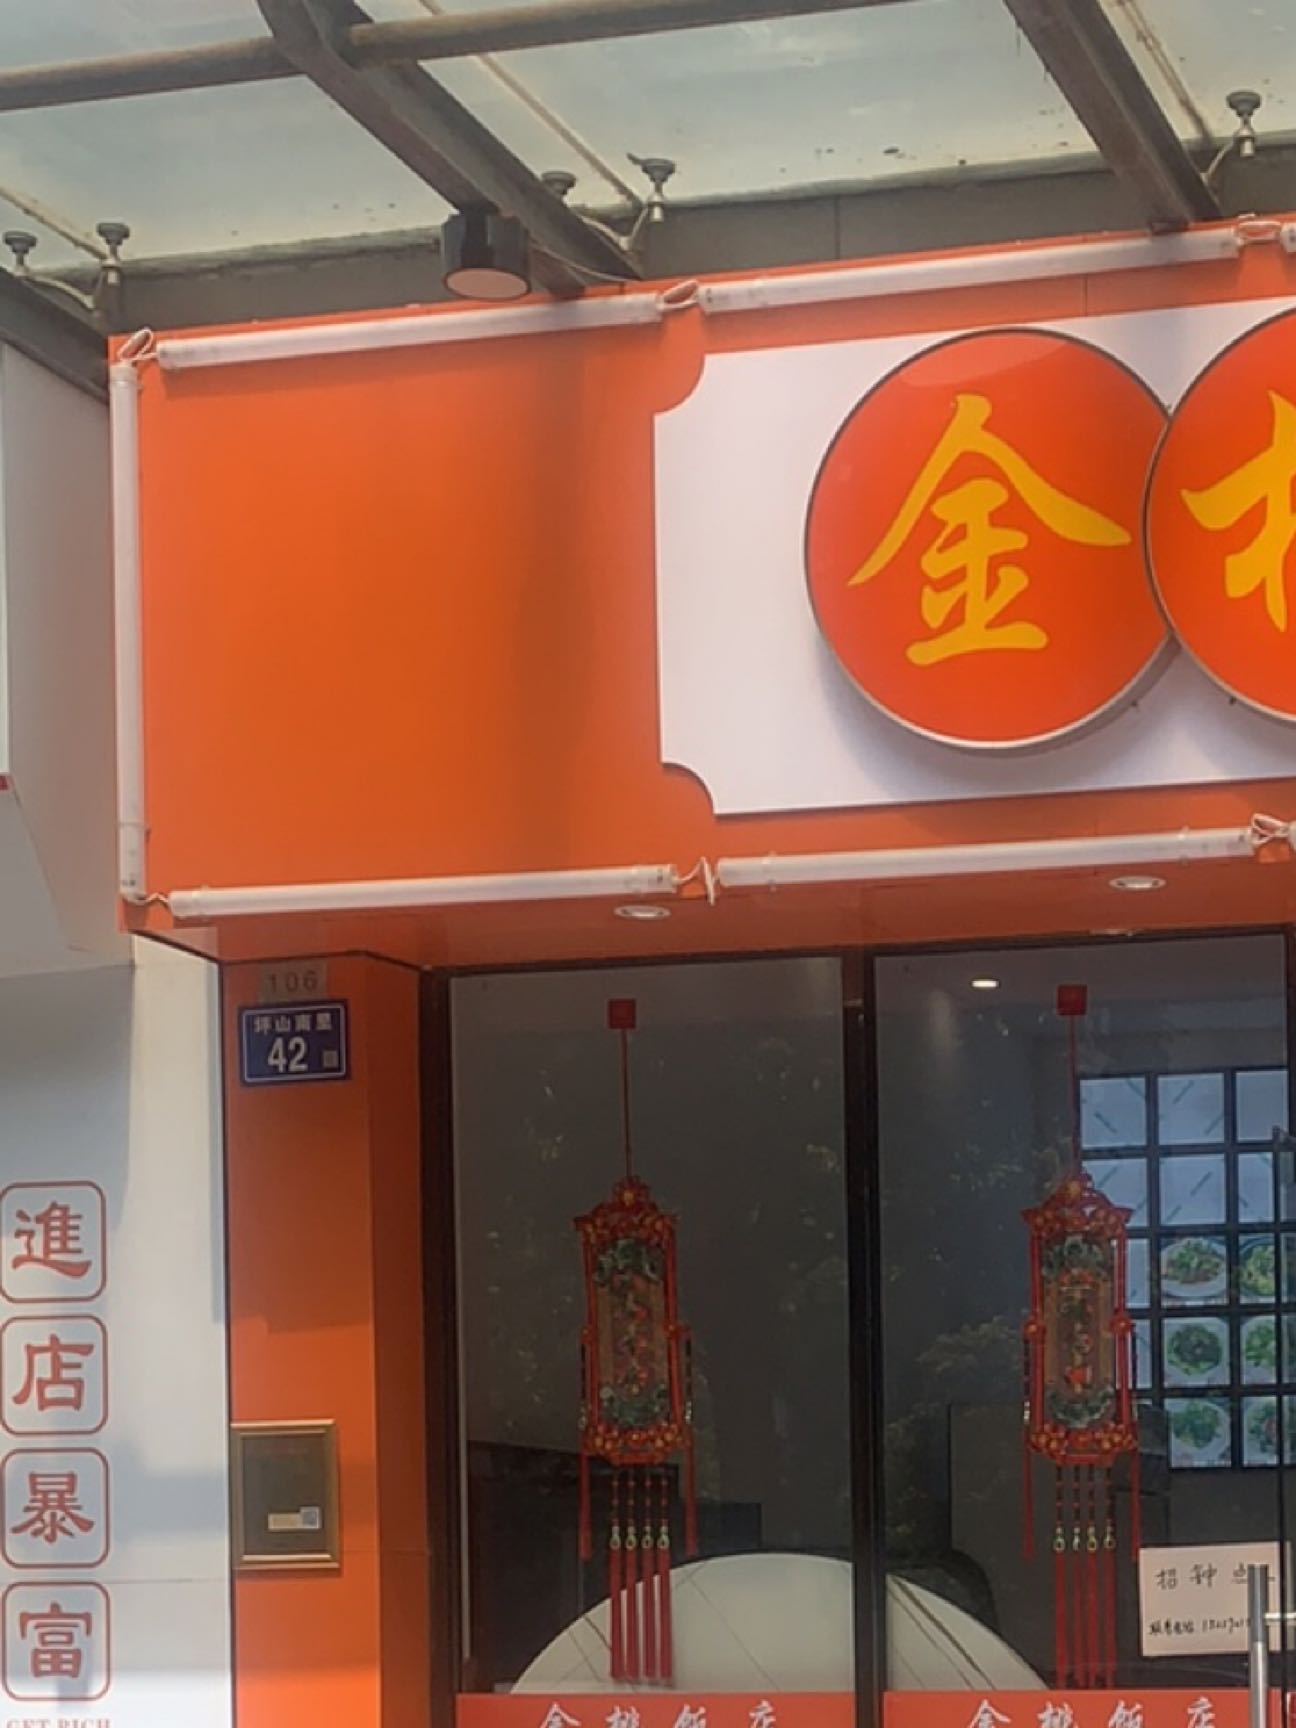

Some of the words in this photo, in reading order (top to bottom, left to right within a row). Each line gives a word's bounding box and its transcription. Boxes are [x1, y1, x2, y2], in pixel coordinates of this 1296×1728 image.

[270, 970, 317, 992] 106
[268, 1037, 308, 1072] 42
[1156, 1563, 1276, 1590] 招钟点
